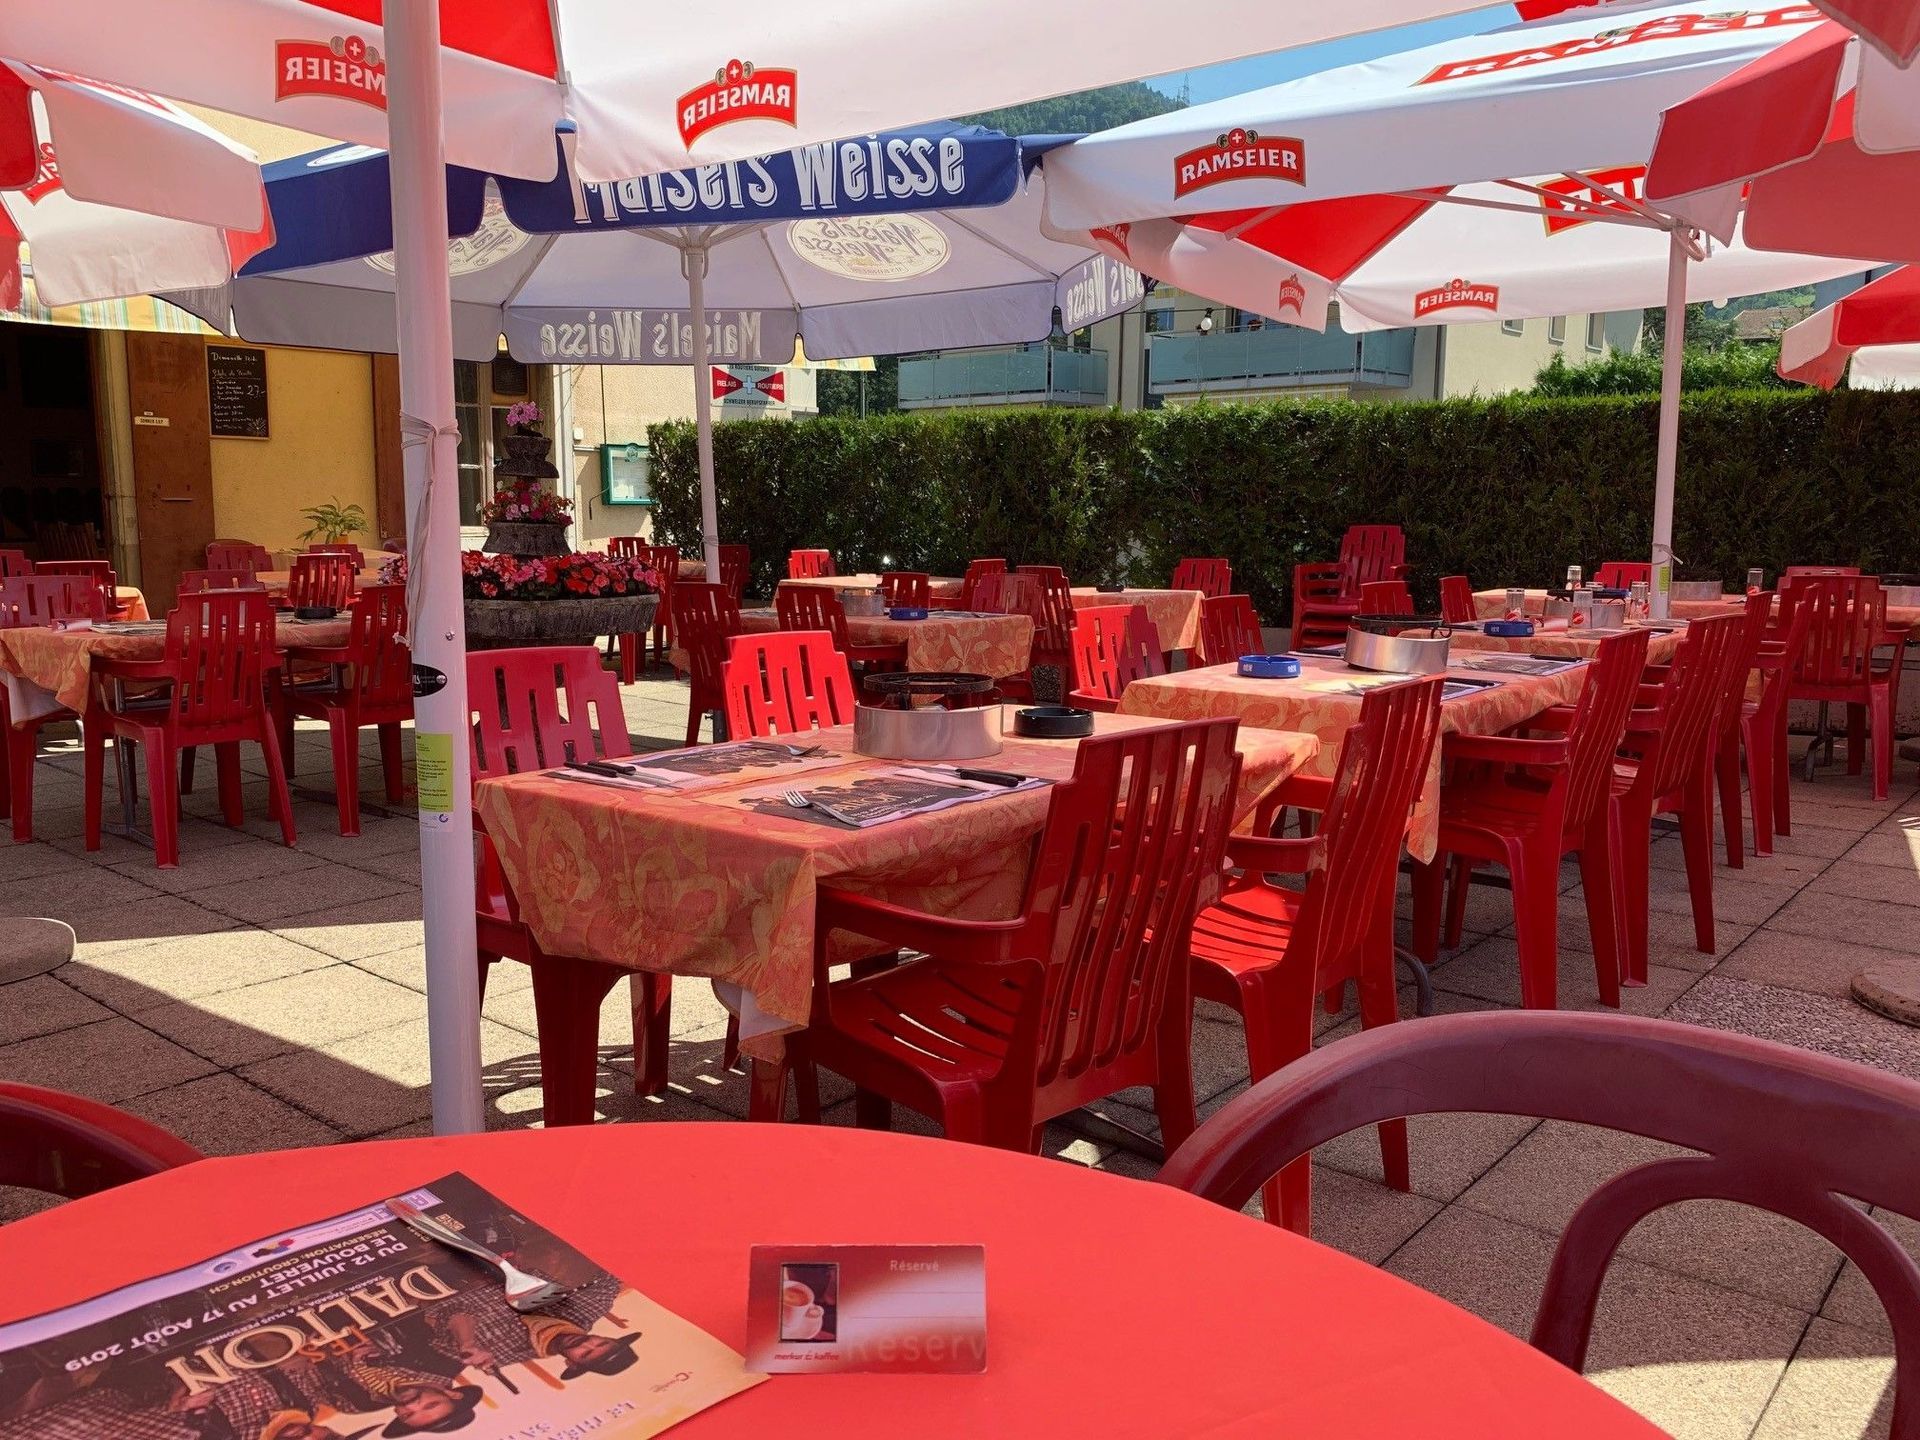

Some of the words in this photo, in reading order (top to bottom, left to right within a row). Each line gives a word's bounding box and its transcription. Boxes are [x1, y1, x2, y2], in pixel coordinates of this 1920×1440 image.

[1446, 9, 1823, 77] RAMSEIE
[790, 134, 966, 211] Weisse
[1181, 148, 1297, 184] RAMSEIER
[716, 380, 737, 388] RELAIS
[757, 382, 784, 391] ROUTIERS
[370, 1233, 398, 1248] LE
[378, 1241, 409, 1257] DU
[260, 1242, 371, 1288] BOUVERET
[351, 1254, 376, 1267] 12
[889, 1259, 940, 1272] Réservé
[267, 1261, 347, 1299] JUILLET
[228, 1293, 258, 1312] AU
[202, 1310, 225, 1323] 17
[165, 1265, 459, 1396] DALTON
[64, 1343, 124, 1372] 2019
